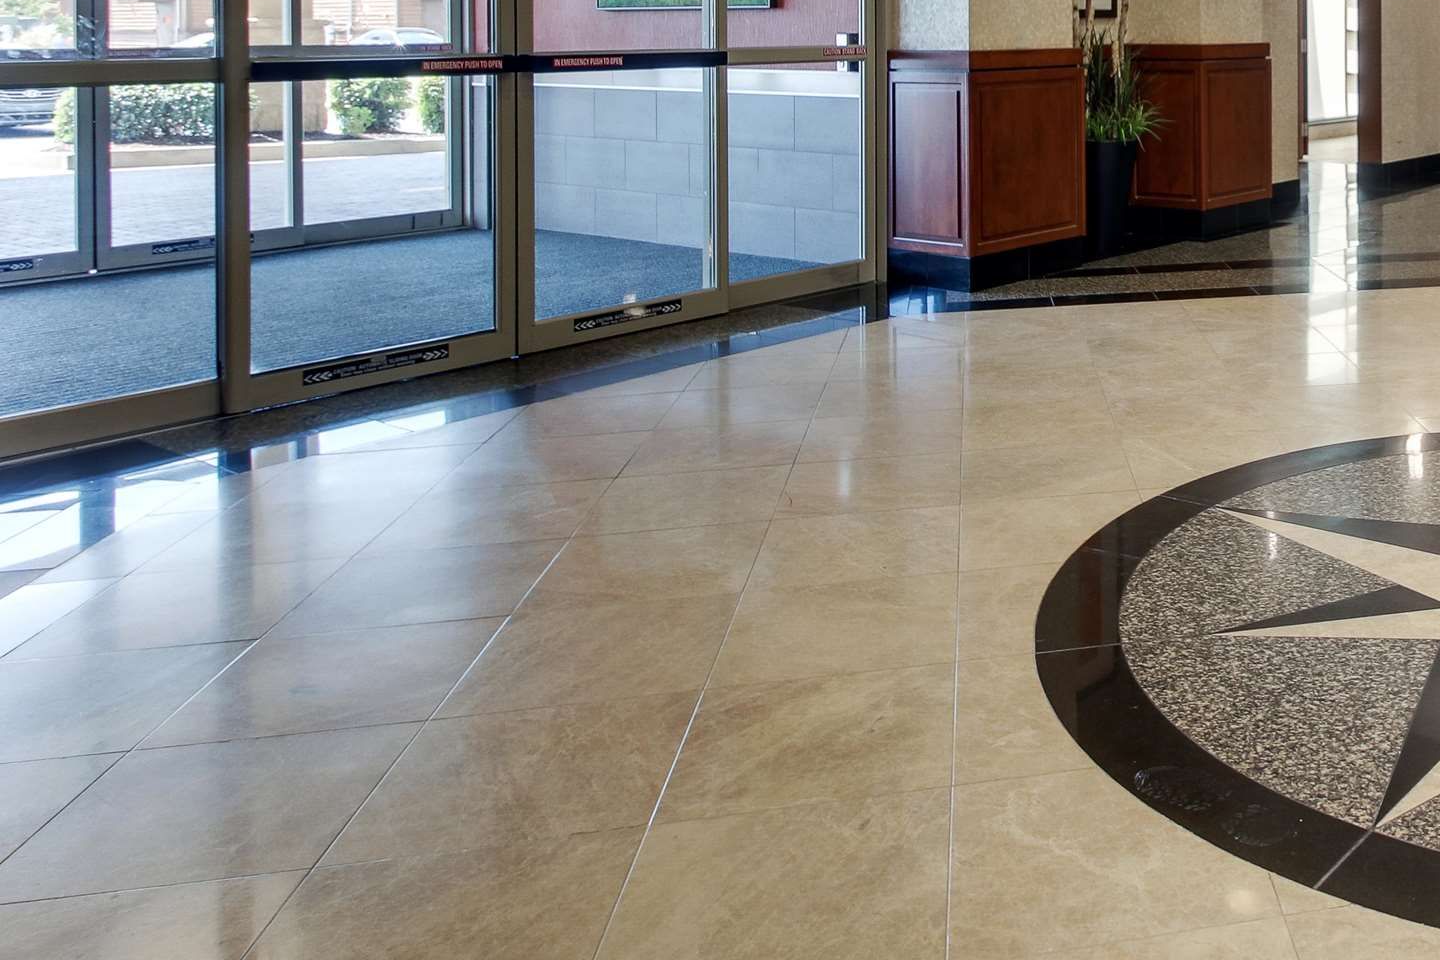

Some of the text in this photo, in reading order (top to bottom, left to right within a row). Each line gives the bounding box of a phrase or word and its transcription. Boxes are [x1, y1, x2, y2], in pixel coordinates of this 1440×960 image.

[423, 59, 503, 70] IN EMERGENCY PUSH TO OPEN
